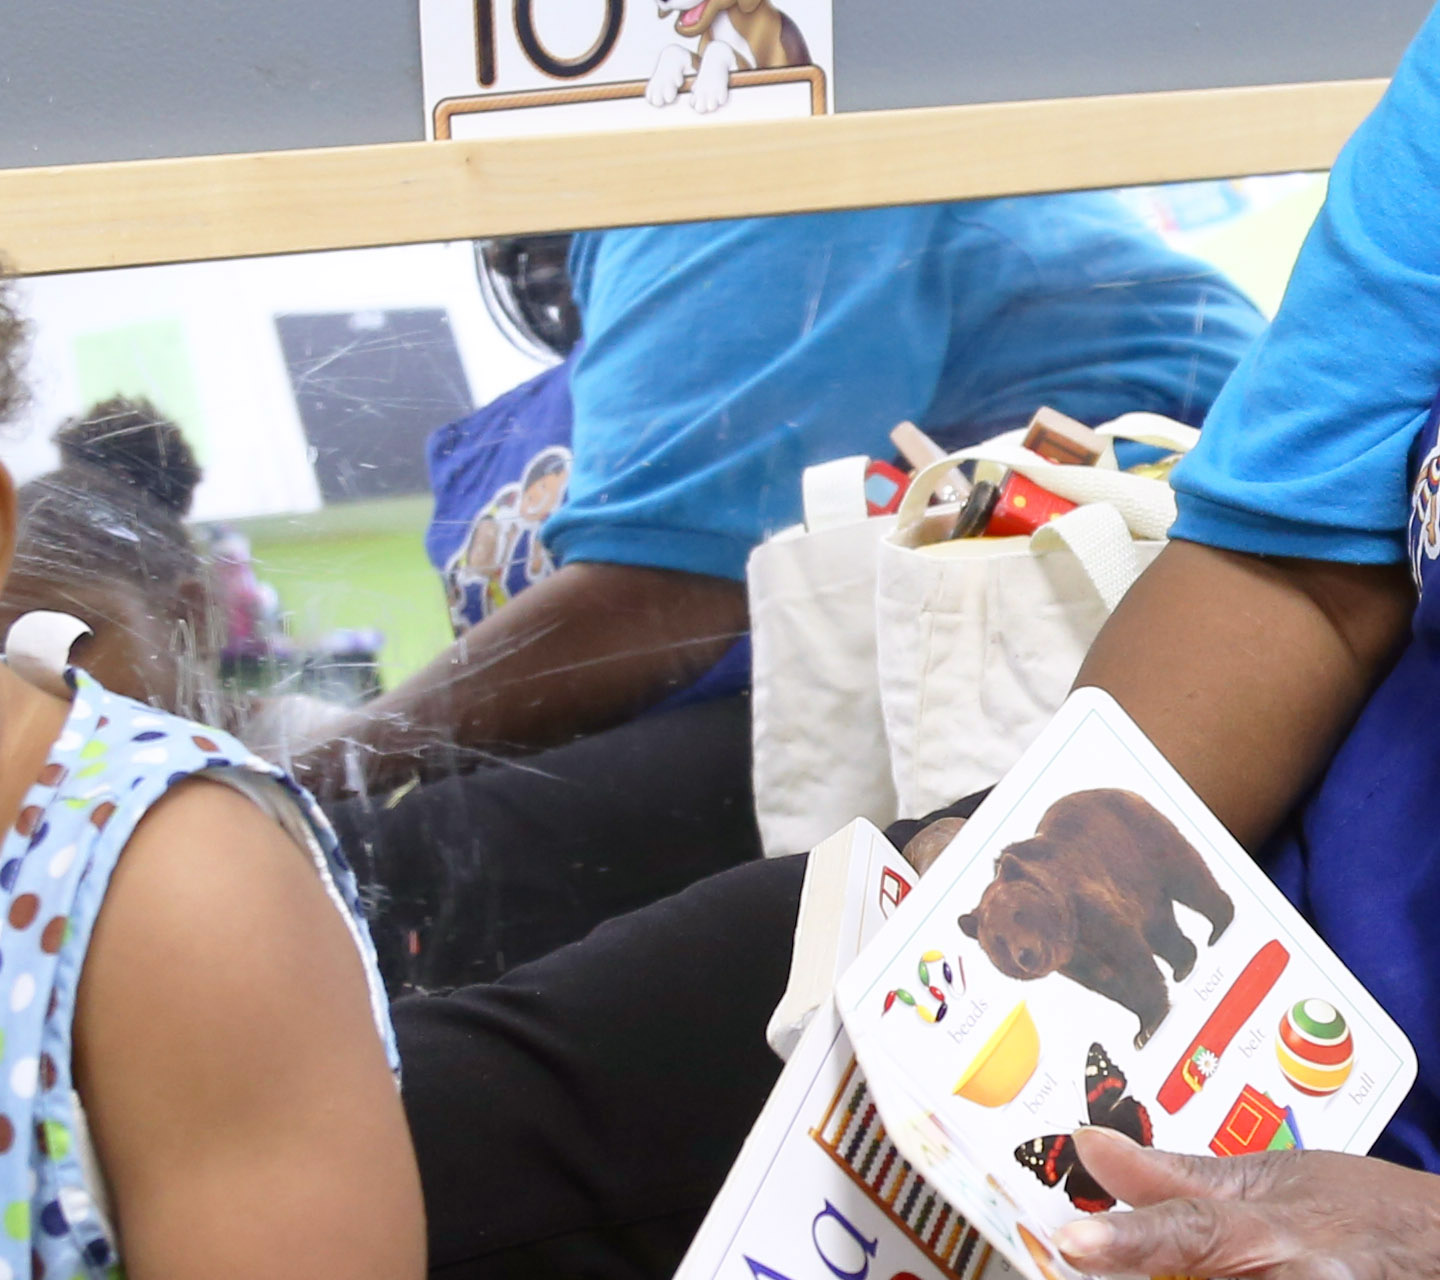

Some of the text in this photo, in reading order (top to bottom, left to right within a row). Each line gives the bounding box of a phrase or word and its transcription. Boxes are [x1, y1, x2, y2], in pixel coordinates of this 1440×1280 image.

[1192, 964, 1225, 1003] bear
[947, 993, 989, 1046] beads
[1237, 1026, 1267, 1059] belt
[1023, 1074, 1059, 1115] bowl
[1349, 1072, 1375, 1108] ball
